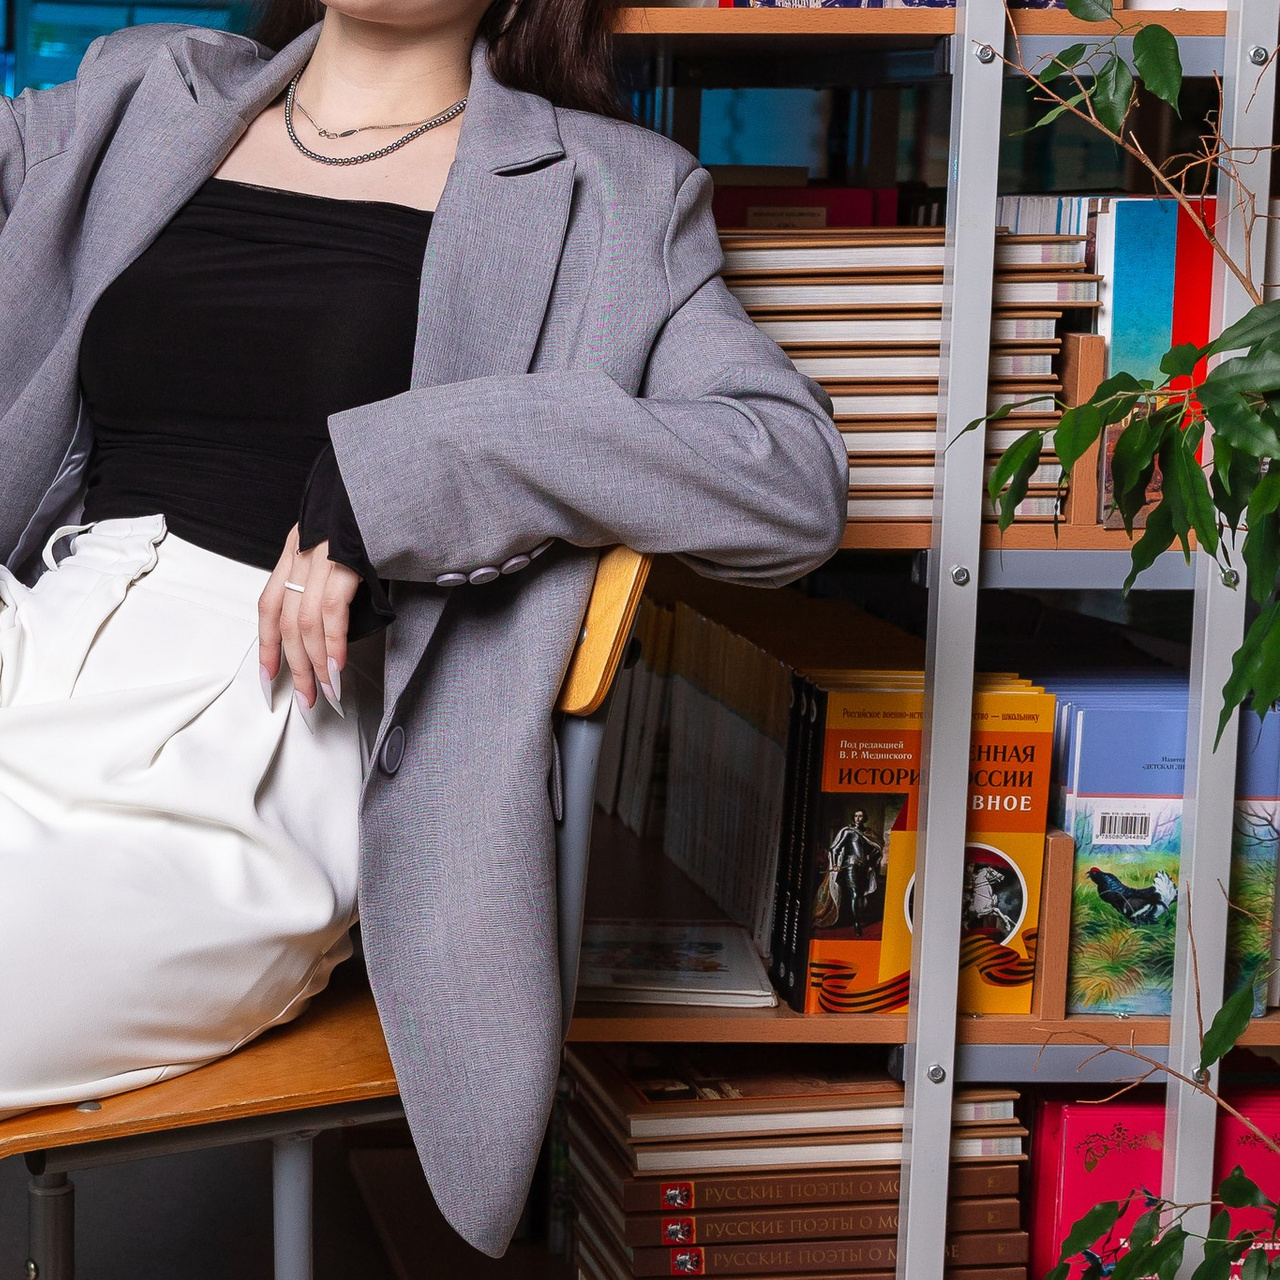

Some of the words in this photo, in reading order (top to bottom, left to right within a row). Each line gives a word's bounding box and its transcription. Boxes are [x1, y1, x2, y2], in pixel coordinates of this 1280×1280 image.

[842, 707, 880, 719] Российское
[1001, 713, 1040, 723] школьнику
[840, 740, 857, 749] Под
[859, 740, 904, 750] редакцией
[839, 751, 849, 759] В.
[851, 751, 858, 759] Р.
[860, 751, 912, 760] Мединского
[838, 768, 920, 786] ИСТОРИ
[969, 770, 1033, 788] ССИИ
[972, 795, 1032, 811] ВНОЕ
[705, 1179, 784, 1202] РУССКИЕ
[790, 1179, 854, 1198] ПОЭТЫ
[860, 1180, 872, 1194] О
[705, 1214, 784, 1237] РУССКИЕ
[790, 1215, 854, 1233] ПОЭТЫ
[859, 1215, 872, 1230] О
